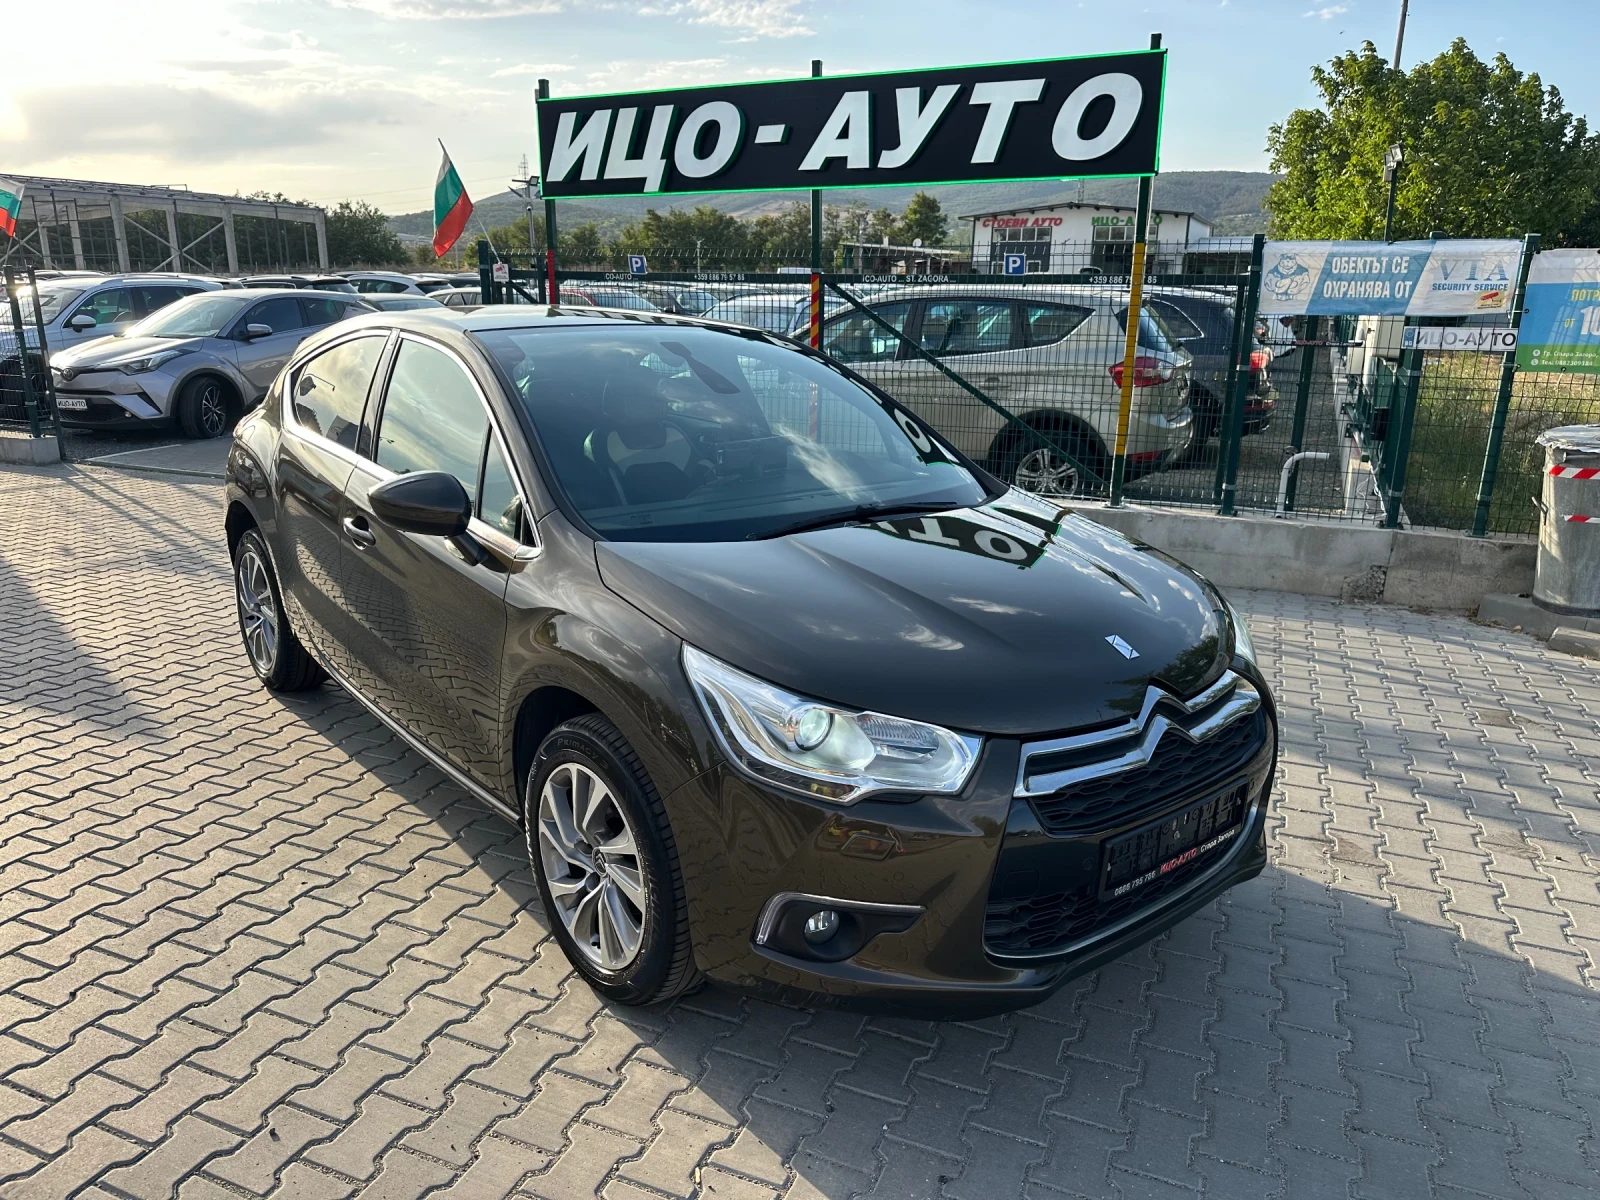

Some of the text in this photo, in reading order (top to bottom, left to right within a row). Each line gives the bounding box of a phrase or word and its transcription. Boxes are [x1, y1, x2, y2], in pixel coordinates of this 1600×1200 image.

[983, 217, 1063, 228] СТОЕВИ АУТО
[1092, 215, 1163, 226] ИЦО-АО
[632, 258, 641, 271] P
[1008, 257, 1020, 273] P
[1332, 256, 1410, 274] ОБЕКТЪТ СЕ
[1436, 259, 1509, 281] VTA
[1089, 276, 1107, 284] +359
[1109, 276, 1123, 284] 886
[1147, 276, 1157, 284] 86
[1432, 283, 1509, 291] SECURITY SERVICE
[1323, 281, 1412, 298] ОХРАНЯВА ОТ
[1571, 288, 1600, 301] ПОТР
[1416, 331, 1517, 347] ИЦО-АУТО
[58, 400, 86, 408] ИЦО-АУТО
[557, 738, 599, 760] PRIMACY
[1159, 848, 1198, 875] ИЦО-АУТО
